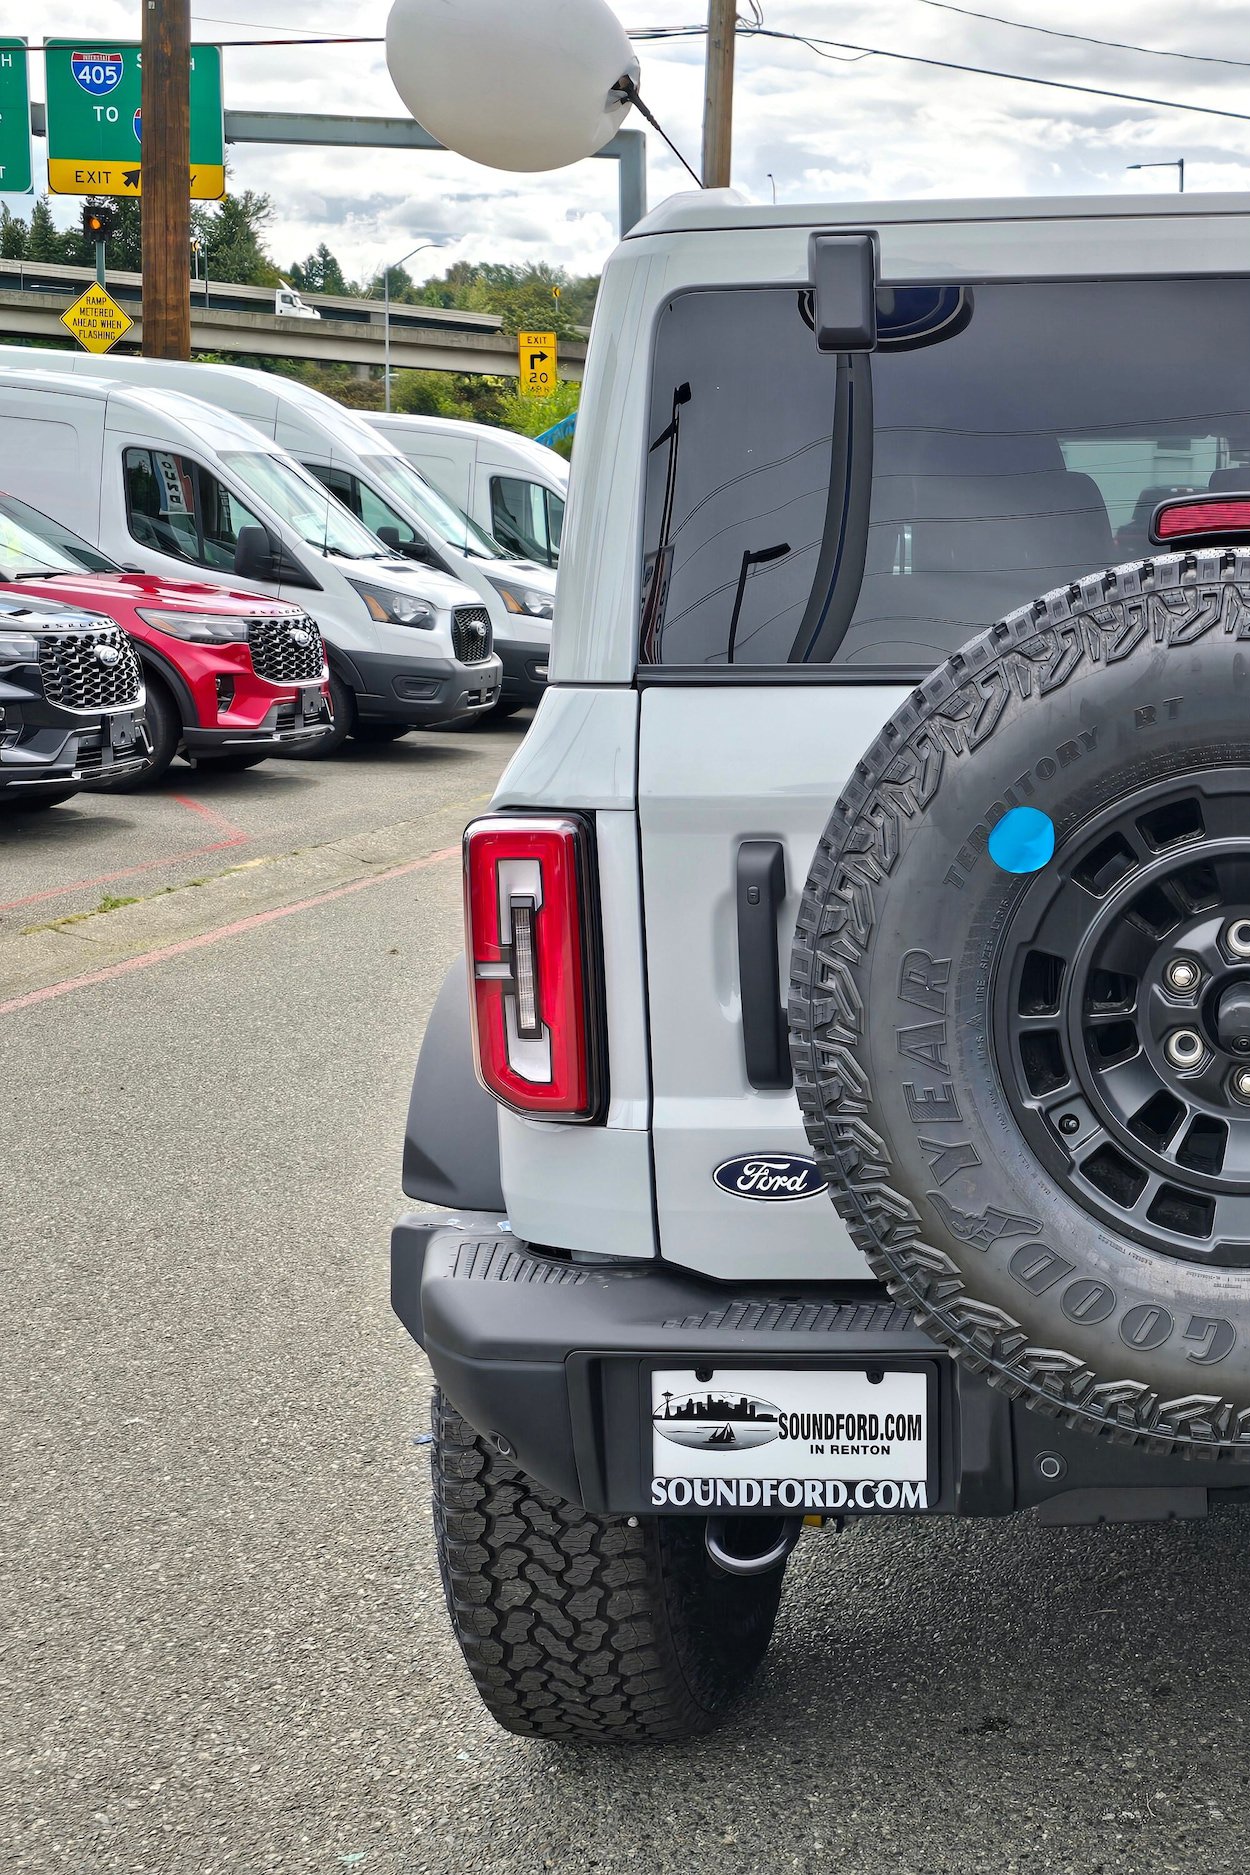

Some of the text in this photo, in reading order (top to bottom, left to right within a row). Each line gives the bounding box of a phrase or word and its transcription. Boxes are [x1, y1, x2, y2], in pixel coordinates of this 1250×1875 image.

[78, 65, 118, 85] 405
[93, 106, 119, 123] TO
[75, 170, 112, 185] EXIT
[86, 296, 107, 306] RAMP
[79, 307, 114, 318] METERED
[72, 318, 122, 329] AHEAD WHEN
[78, 329, 116, 341] FLASHING
[527, 336, 547, 344] EXIT
[529, 372, 549, 384] 20
[736, 1161, 809, 1191] Ford
[778, 1412, 922, 1441] SOUNDFORD.COM
[810, 1444, 891, 1456] IN RENTON
[650, 1477, 929, 1510] SOUNDFORD.COM
